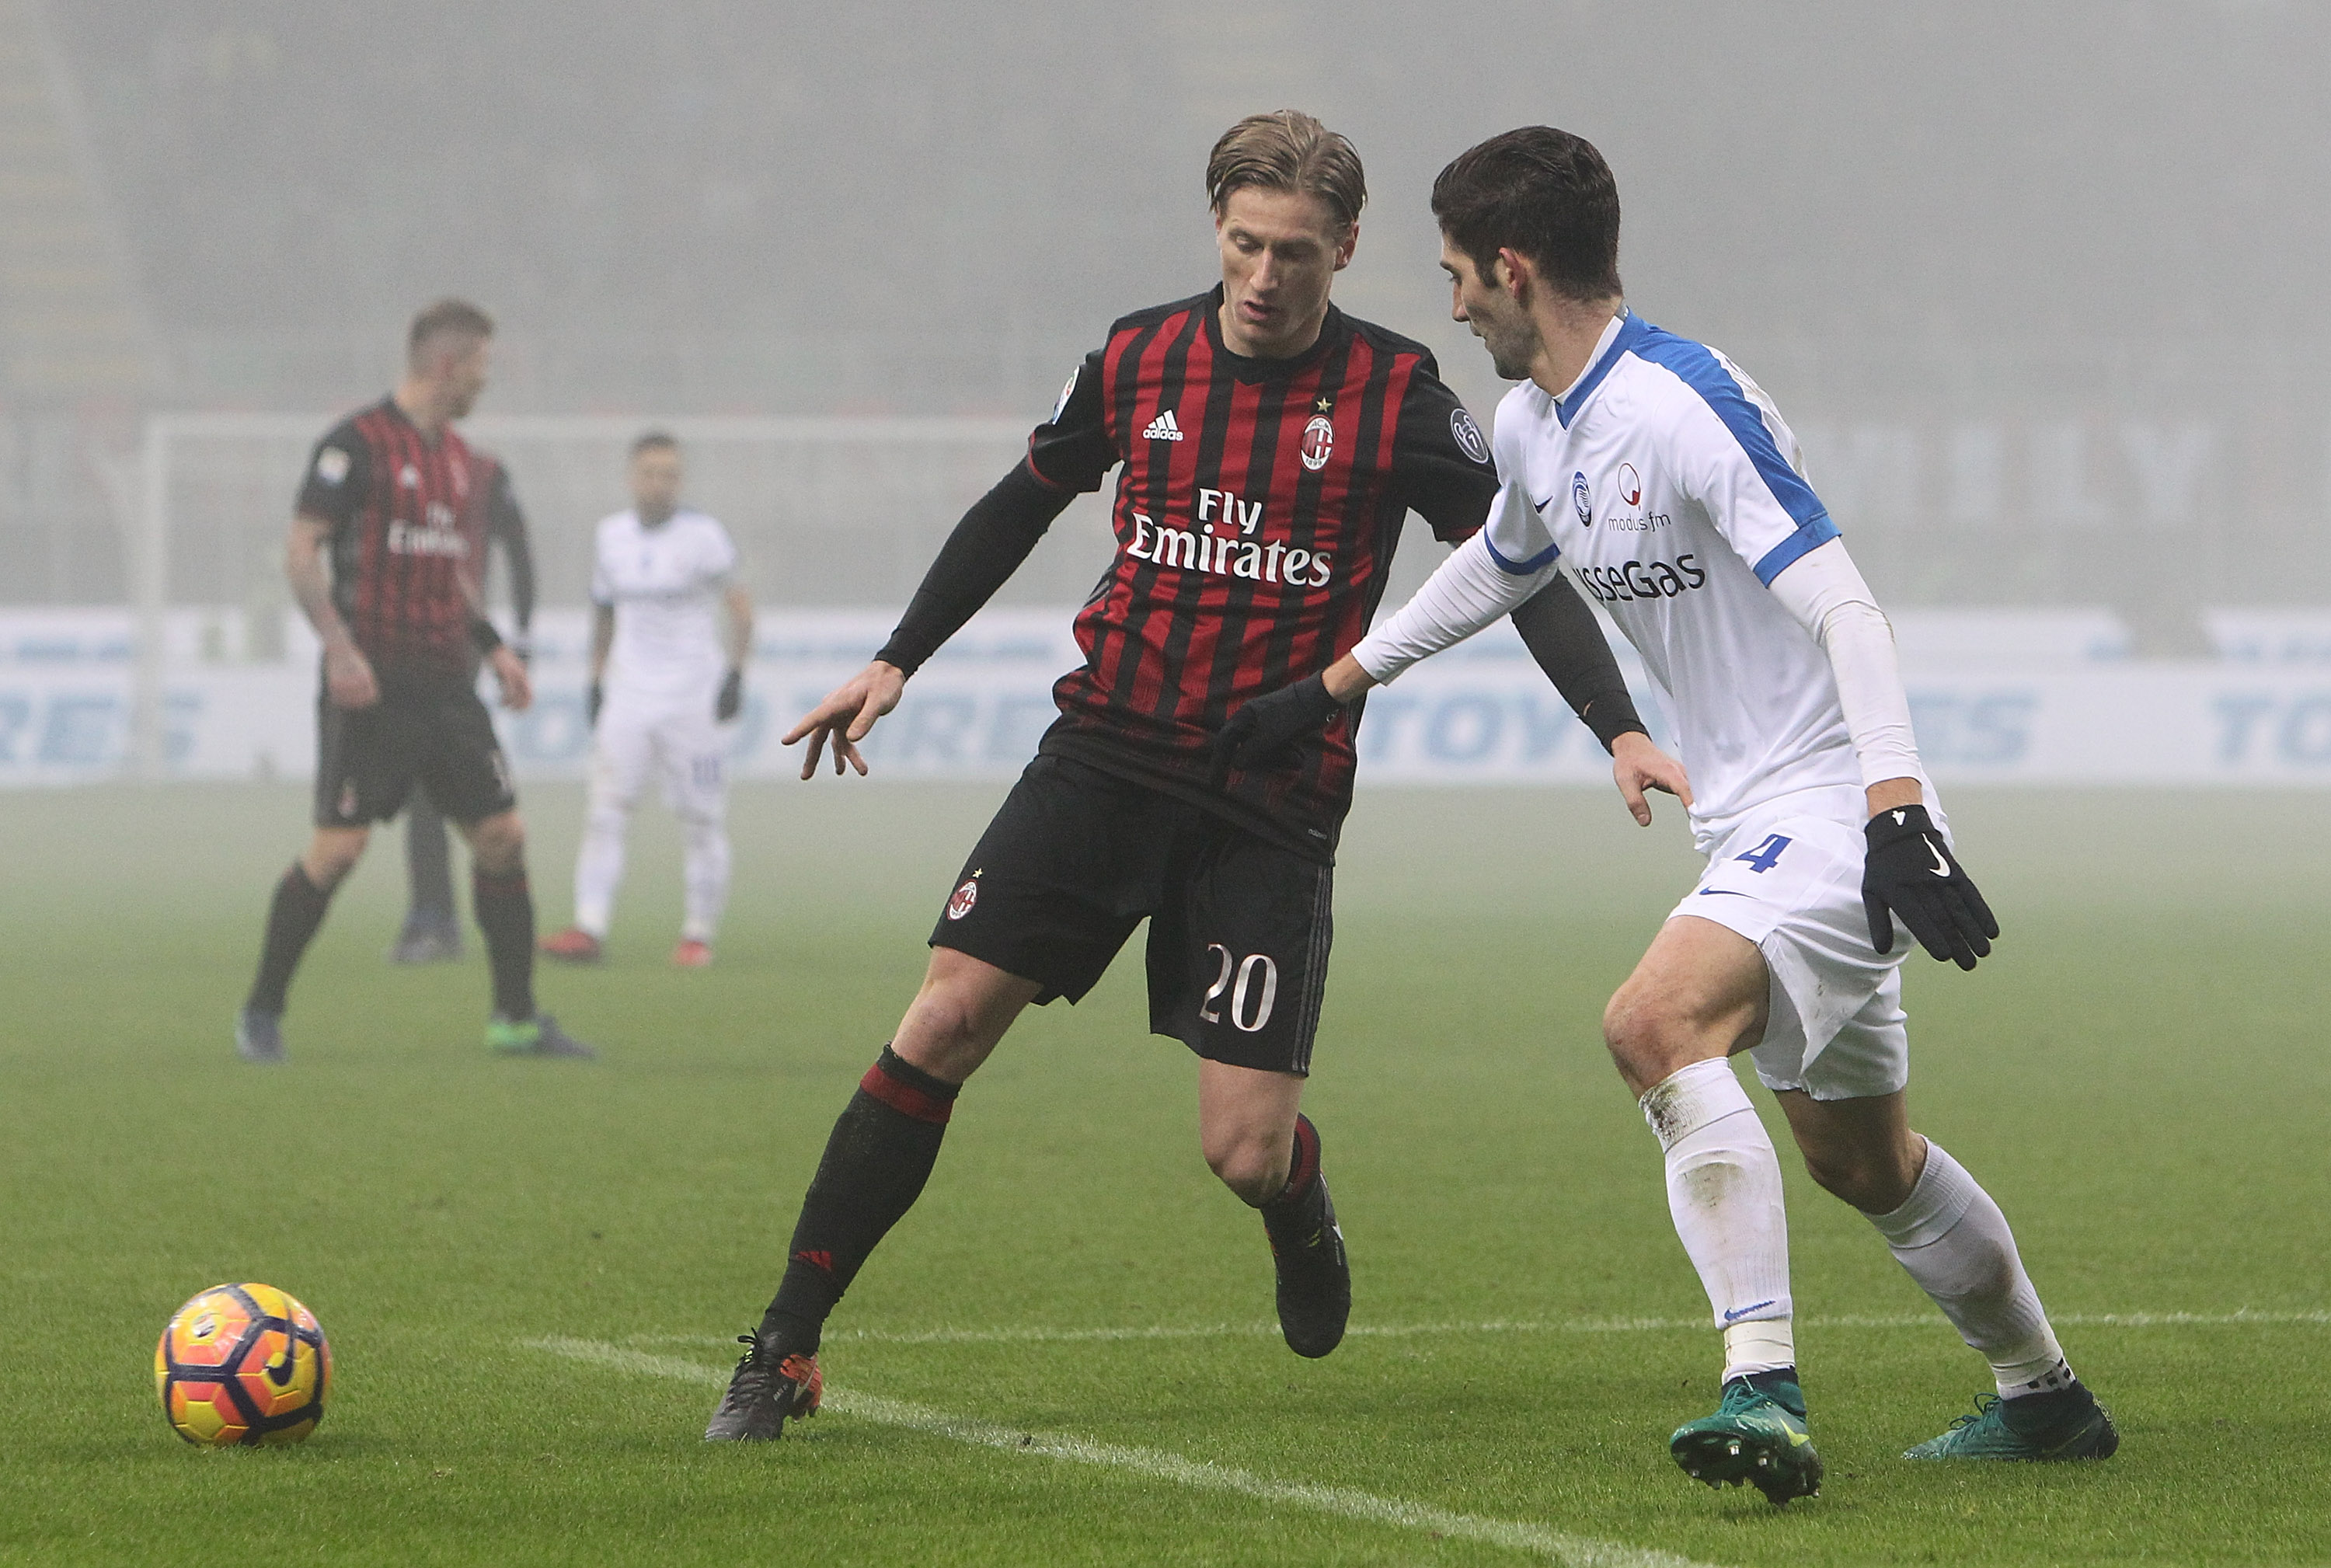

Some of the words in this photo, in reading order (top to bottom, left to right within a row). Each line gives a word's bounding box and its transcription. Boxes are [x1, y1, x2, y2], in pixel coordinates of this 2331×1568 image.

[1143, 427, 1183, 441] adidas
[1305, 458, 1322, 467] 1899
[1198, 487, 1263, 535] Fly
[1608, 513, 1648, 531] modus
[1648, 511, 1671, 532] fm
[1127, 512, 1331, 587] Emirates
[1573, 554, 1706, 601] sseGas
[1733, 833, 1793, 874] 4
[1199, 943, 1277, 1032] 20
